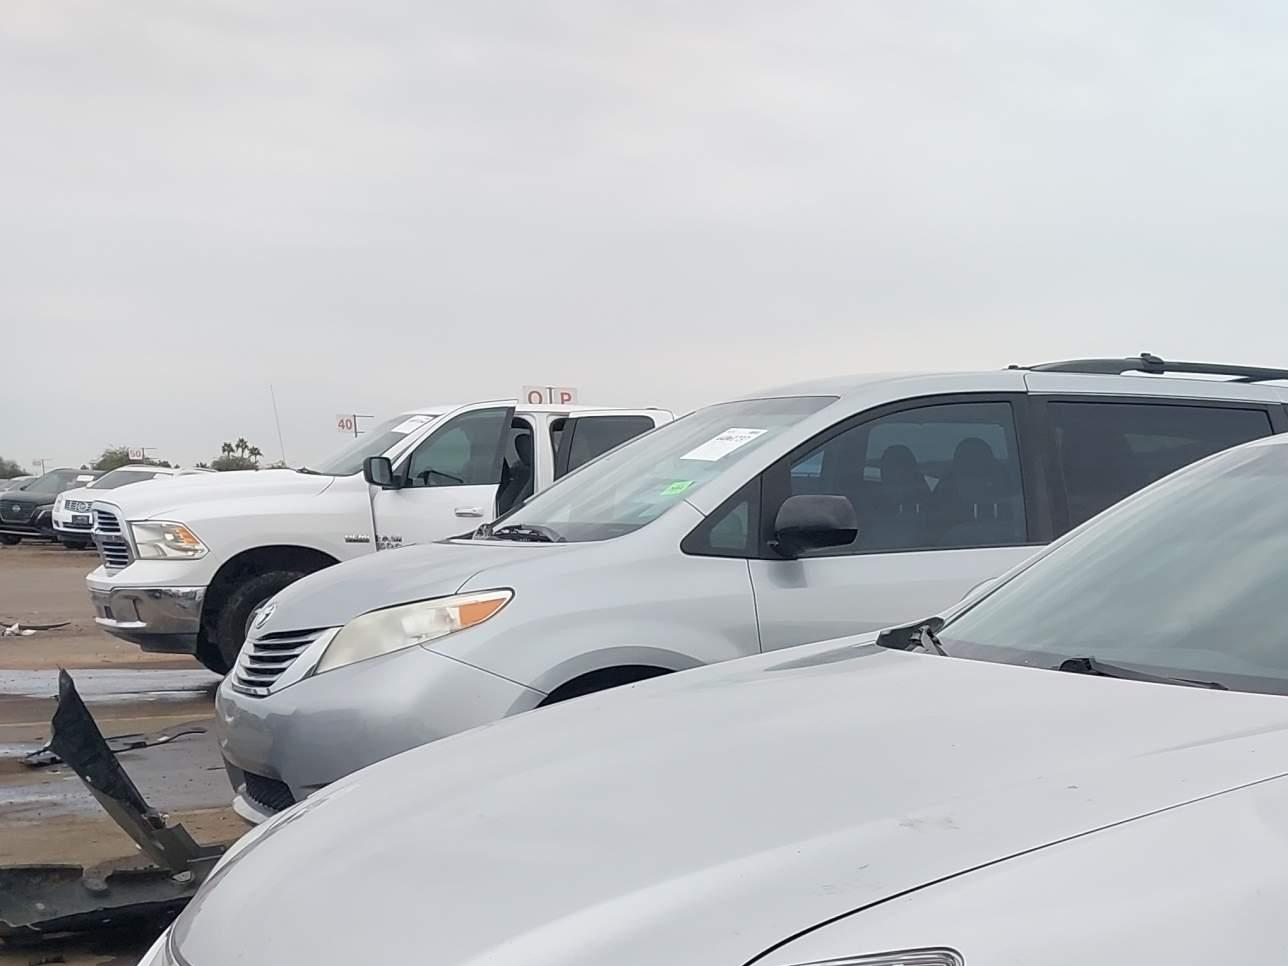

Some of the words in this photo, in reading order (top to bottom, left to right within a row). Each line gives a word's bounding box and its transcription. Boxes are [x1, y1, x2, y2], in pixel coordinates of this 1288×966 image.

[560, 391, 572, 404] P
[337, 418, 353, 430] 40
[129, 449, 142, 458] 50
